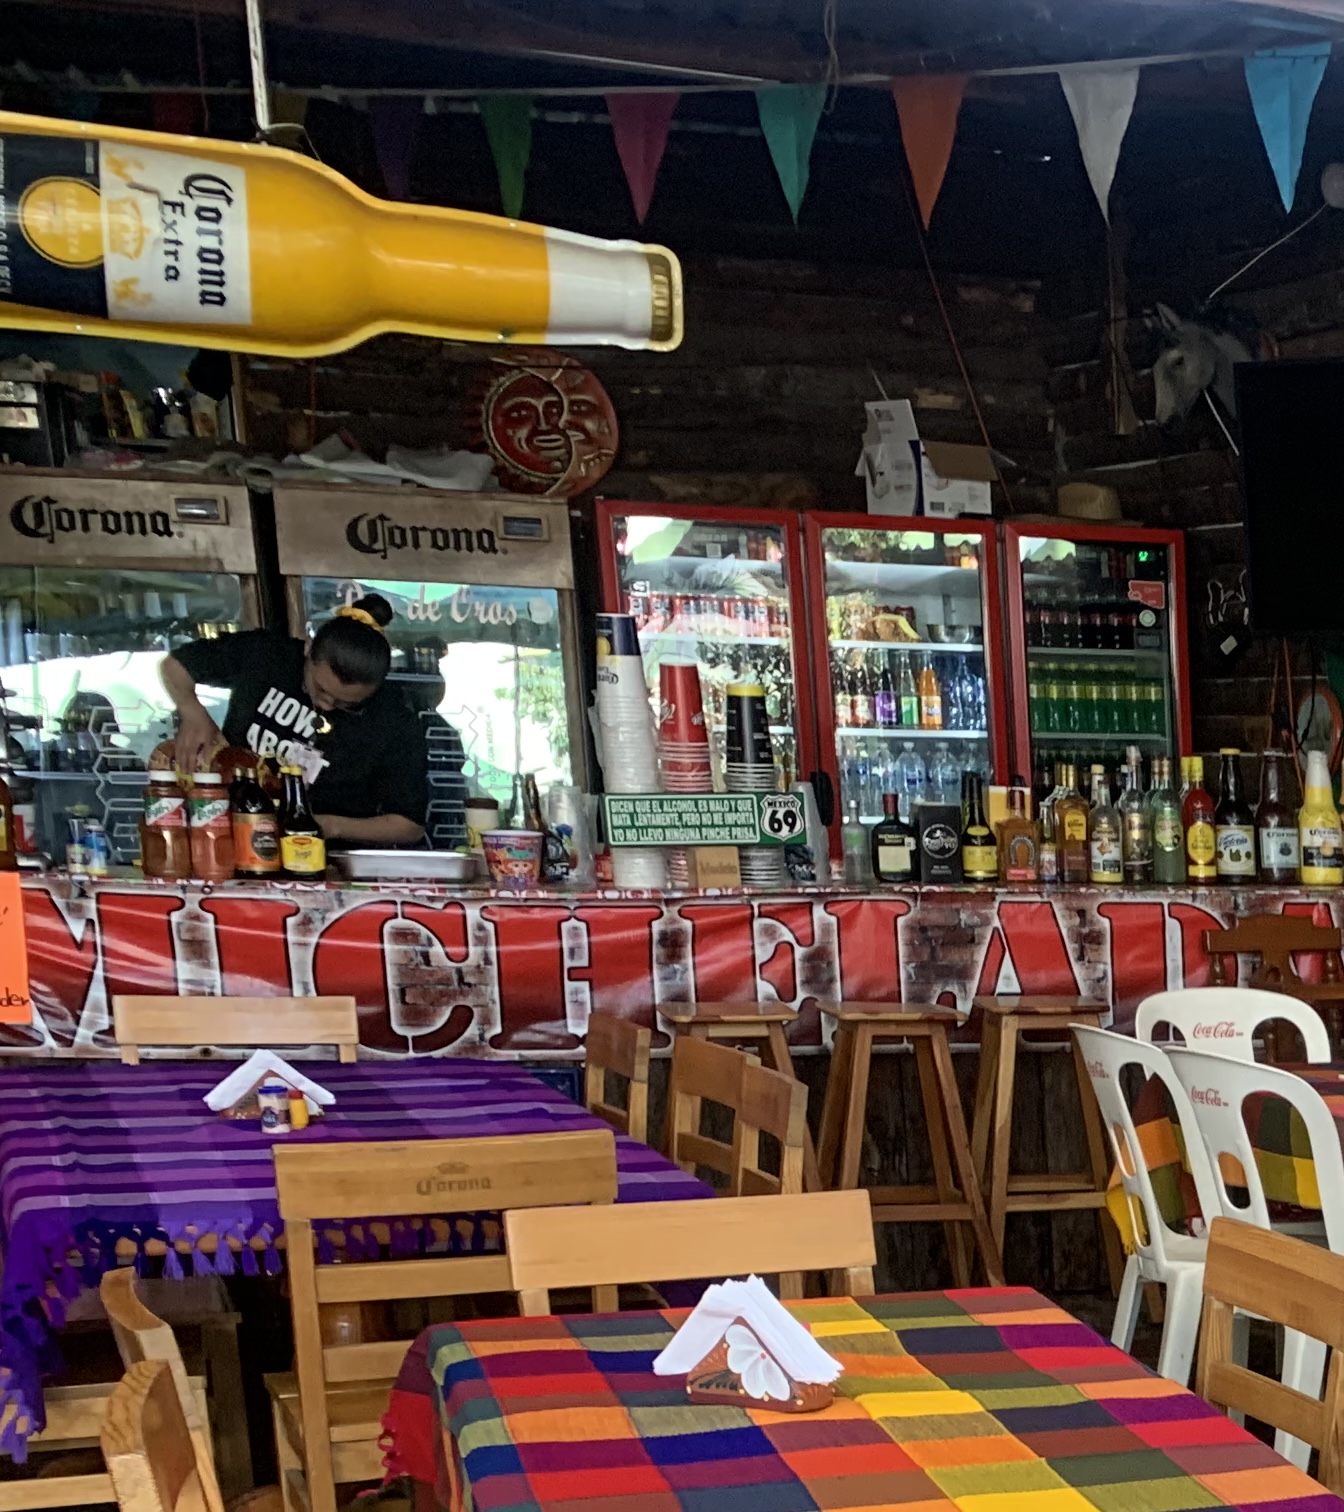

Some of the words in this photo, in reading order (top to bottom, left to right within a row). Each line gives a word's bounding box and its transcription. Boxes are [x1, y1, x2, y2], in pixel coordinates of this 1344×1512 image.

[161, 199, 187, 283] Extra
[179, 173, 234, 308] Corona
[11, 495, 175, 542] Corona
[346, 512, 501, 560] Corona
[407, 584, 441, 622] de
[257, 686, 317, 737] HOW
[610, 800, 634, 812] DICEN
[635, 800, 651, 812] QUE
[652, 800, 662, 812] EL
[663, 800, 697, 812] ALCOHOL
[700, 800, 708, 812] ES
[709, 800, 729, 812] MALO
[730, 800, 737, 812] Y
[737, 800, 752, 812] QUE
[612, 813, 632, 826] MATA
[682, 813, 700, 826] PERO
[702, 813, 712, 825] NO
[713, 813, 724, 825] ME
[725, 813, 754, 825] IMPORTA
[769, 809, 797, 834] 69
[614, 828, 625, 840] YO
[626, 828, 638, 840] NO
[639, 828, 664, 840] LLEVO
[665, 828, 700, 840] NINGUNA
[702, 828, 731, 840] PINCHE
[1193, 1022, 1235, 1039] Coca-Cola
